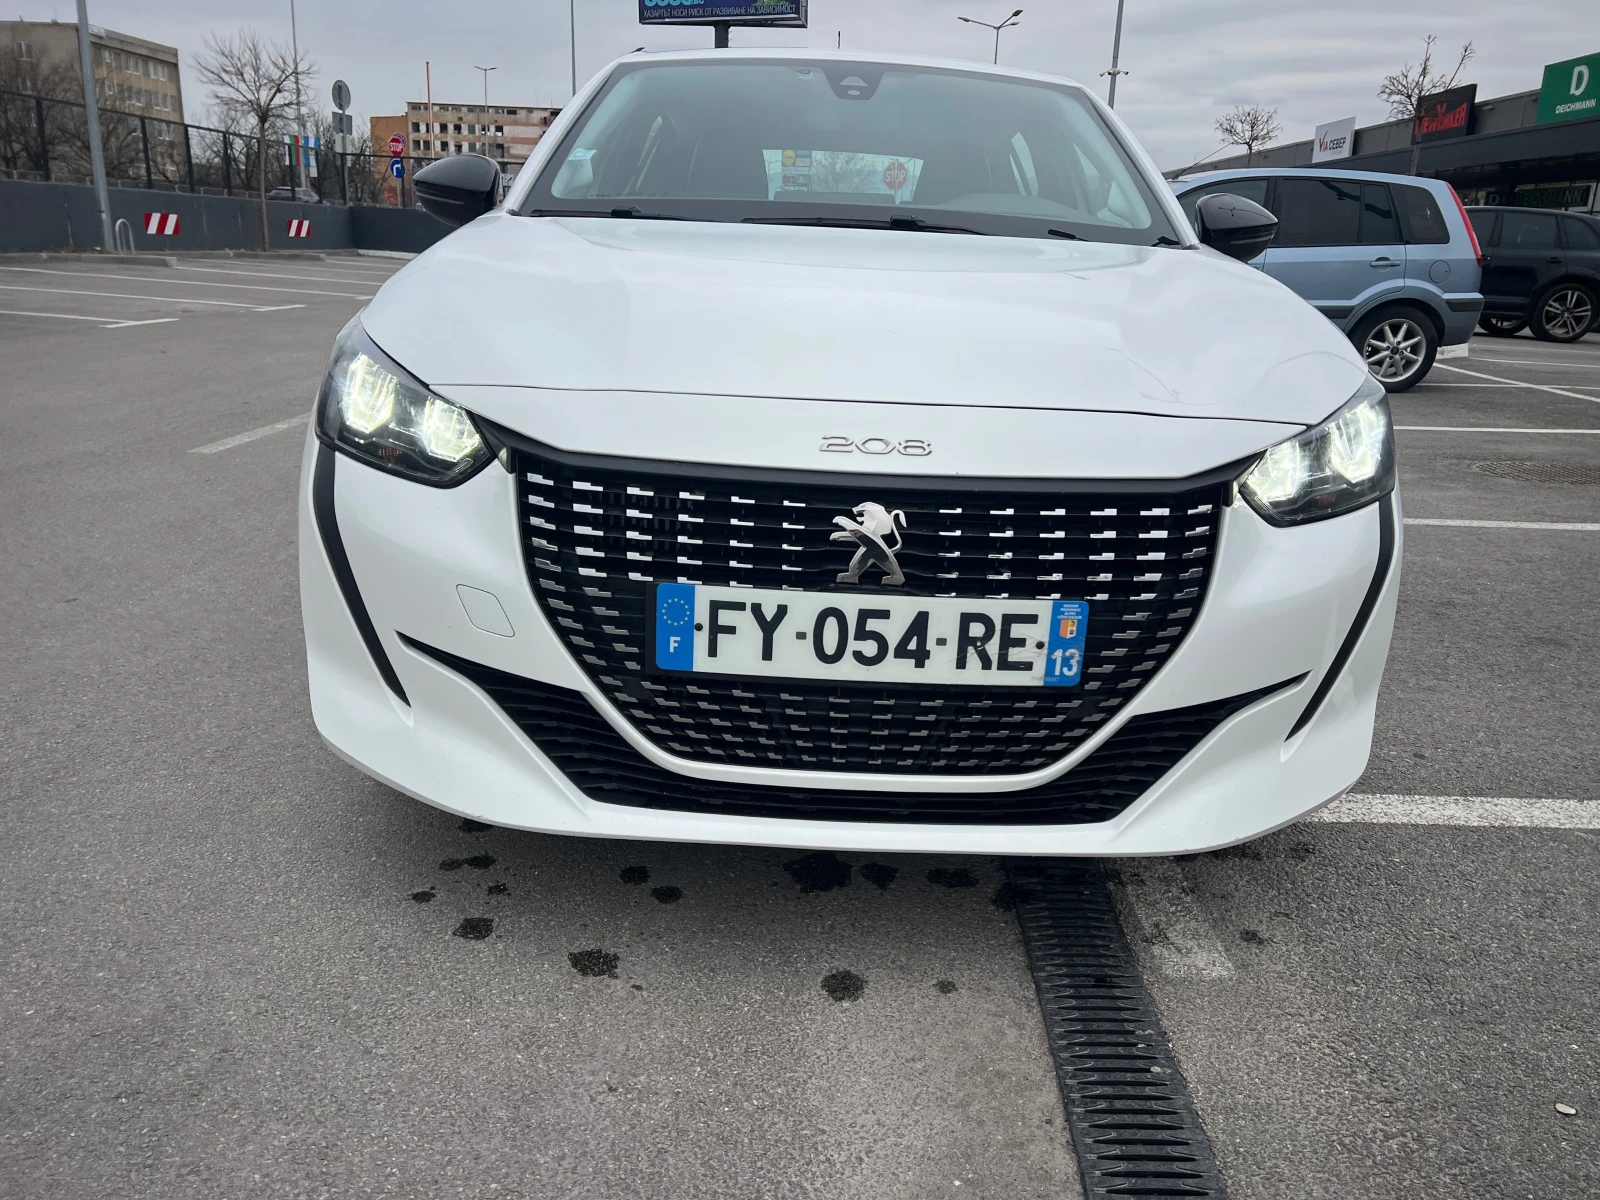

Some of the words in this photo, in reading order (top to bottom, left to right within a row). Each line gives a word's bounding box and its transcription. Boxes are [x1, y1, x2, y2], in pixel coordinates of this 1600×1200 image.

[643, 8, 671, 18] ХАЗАРТЪТ
[671, 8, 688, 17] НОСИ
[688, 7, 704, 16] РИСК
[704, 7, 712, 15] ОТ
[712, 6, 747, 15] РАЗВИВАНЕ
[747, 6, 756, 14] НА
[756, 5, 796, 14] ЗАВИСИМОСТ
[1569, 64, 1590, 96] D
[1555, 98, 1597, 114] DEICHMANN
[389, 142, 403, 152] STOP
[885, 170, 906, 182] STOP
[819, 435, 932, 457] 208
[669, 636, 681, 653] F
[707, 600, 1040, 672] FY-054-RE
[1051, 648, 1080, 677] 13
